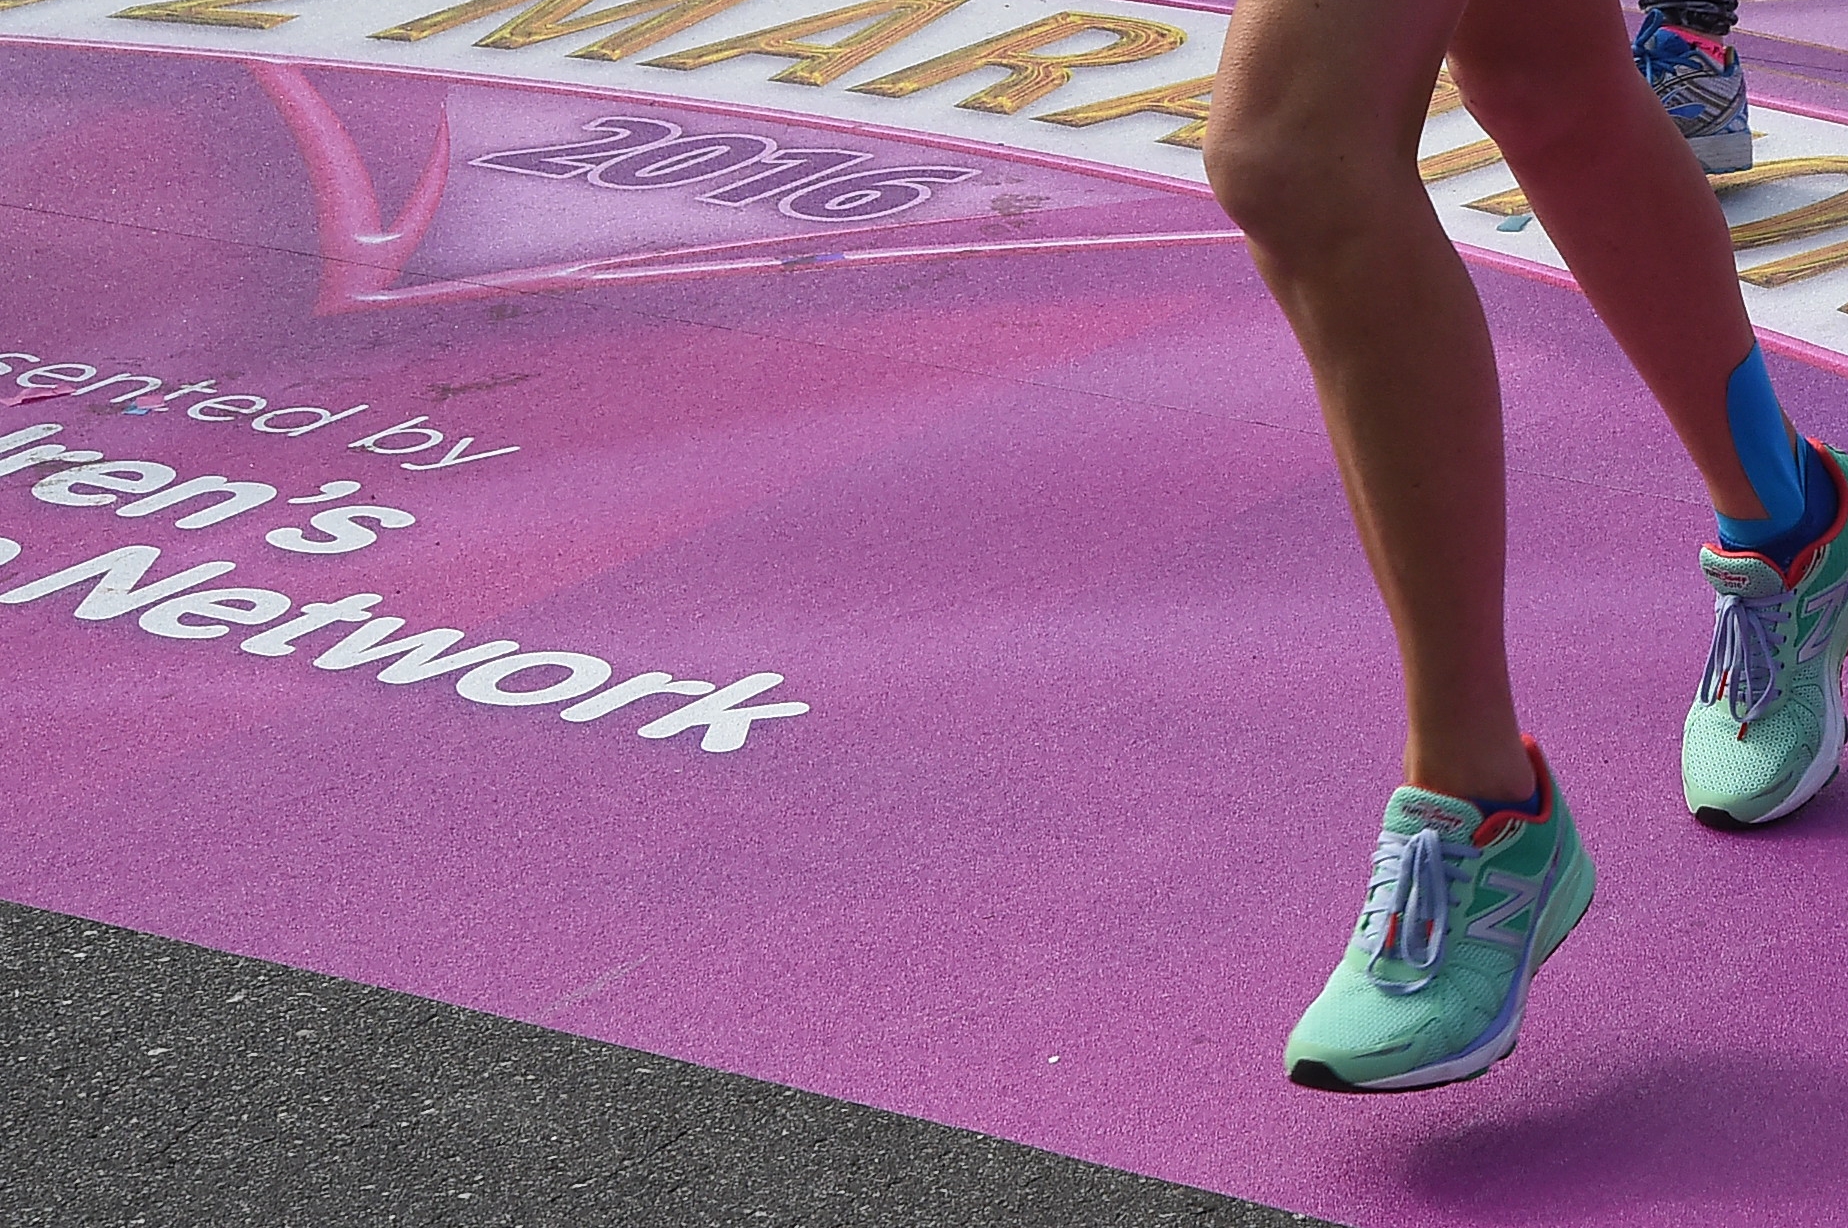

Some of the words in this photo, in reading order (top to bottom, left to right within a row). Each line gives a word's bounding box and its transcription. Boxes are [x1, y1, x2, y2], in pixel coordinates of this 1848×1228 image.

[470, 115, 982, 224] 2016
[347, 415, 521, 471] by
[0, 545, 811, 755] Network
